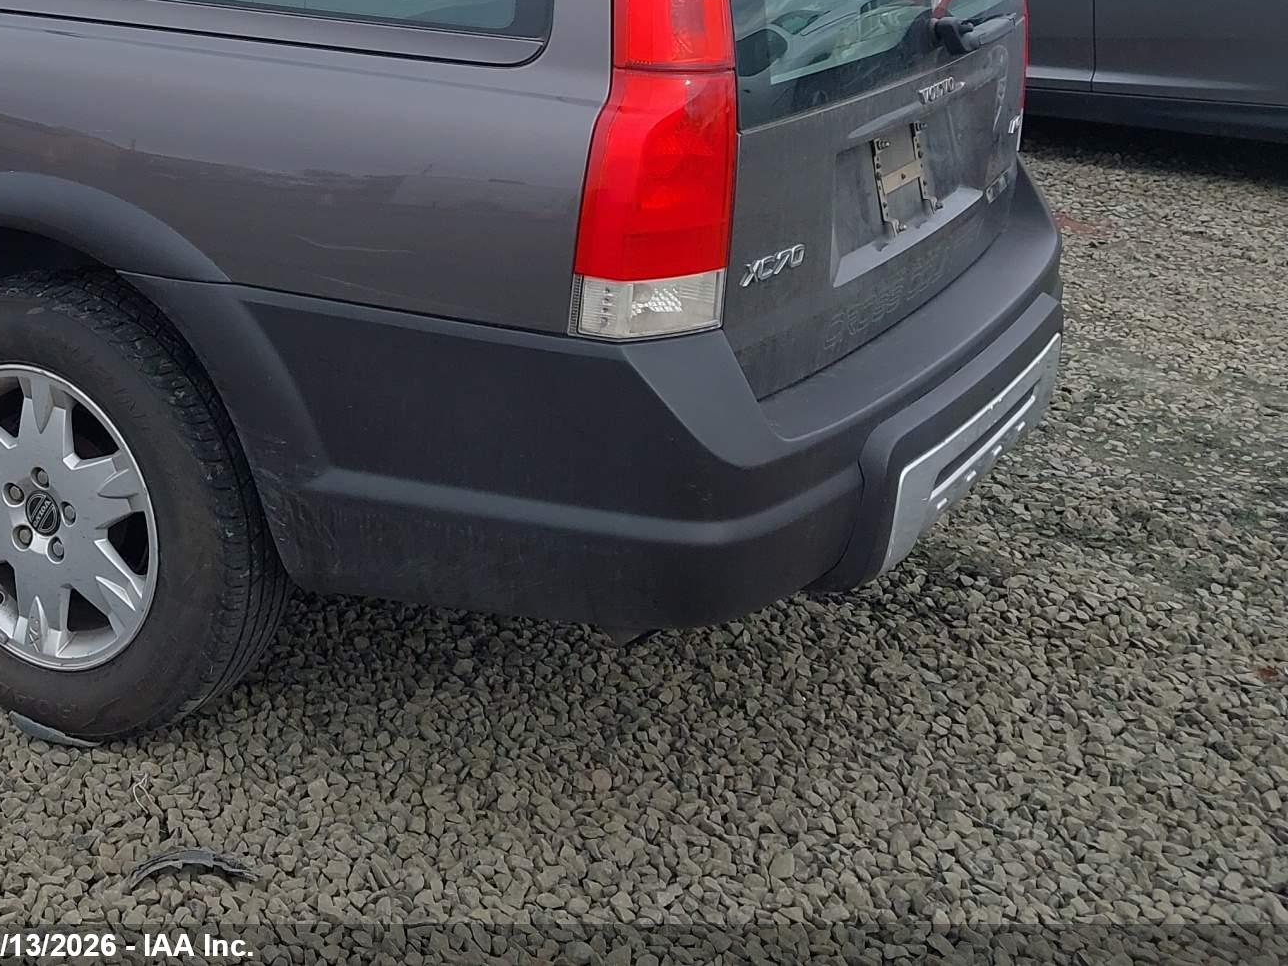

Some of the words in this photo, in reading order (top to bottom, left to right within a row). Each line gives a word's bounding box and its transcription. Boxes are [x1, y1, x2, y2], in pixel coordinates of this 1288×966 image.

[918, 76, 954, 104] VOLVO
[739, 244, 806, 287] XC70
[32, 500, 52, 528] VOLVO
